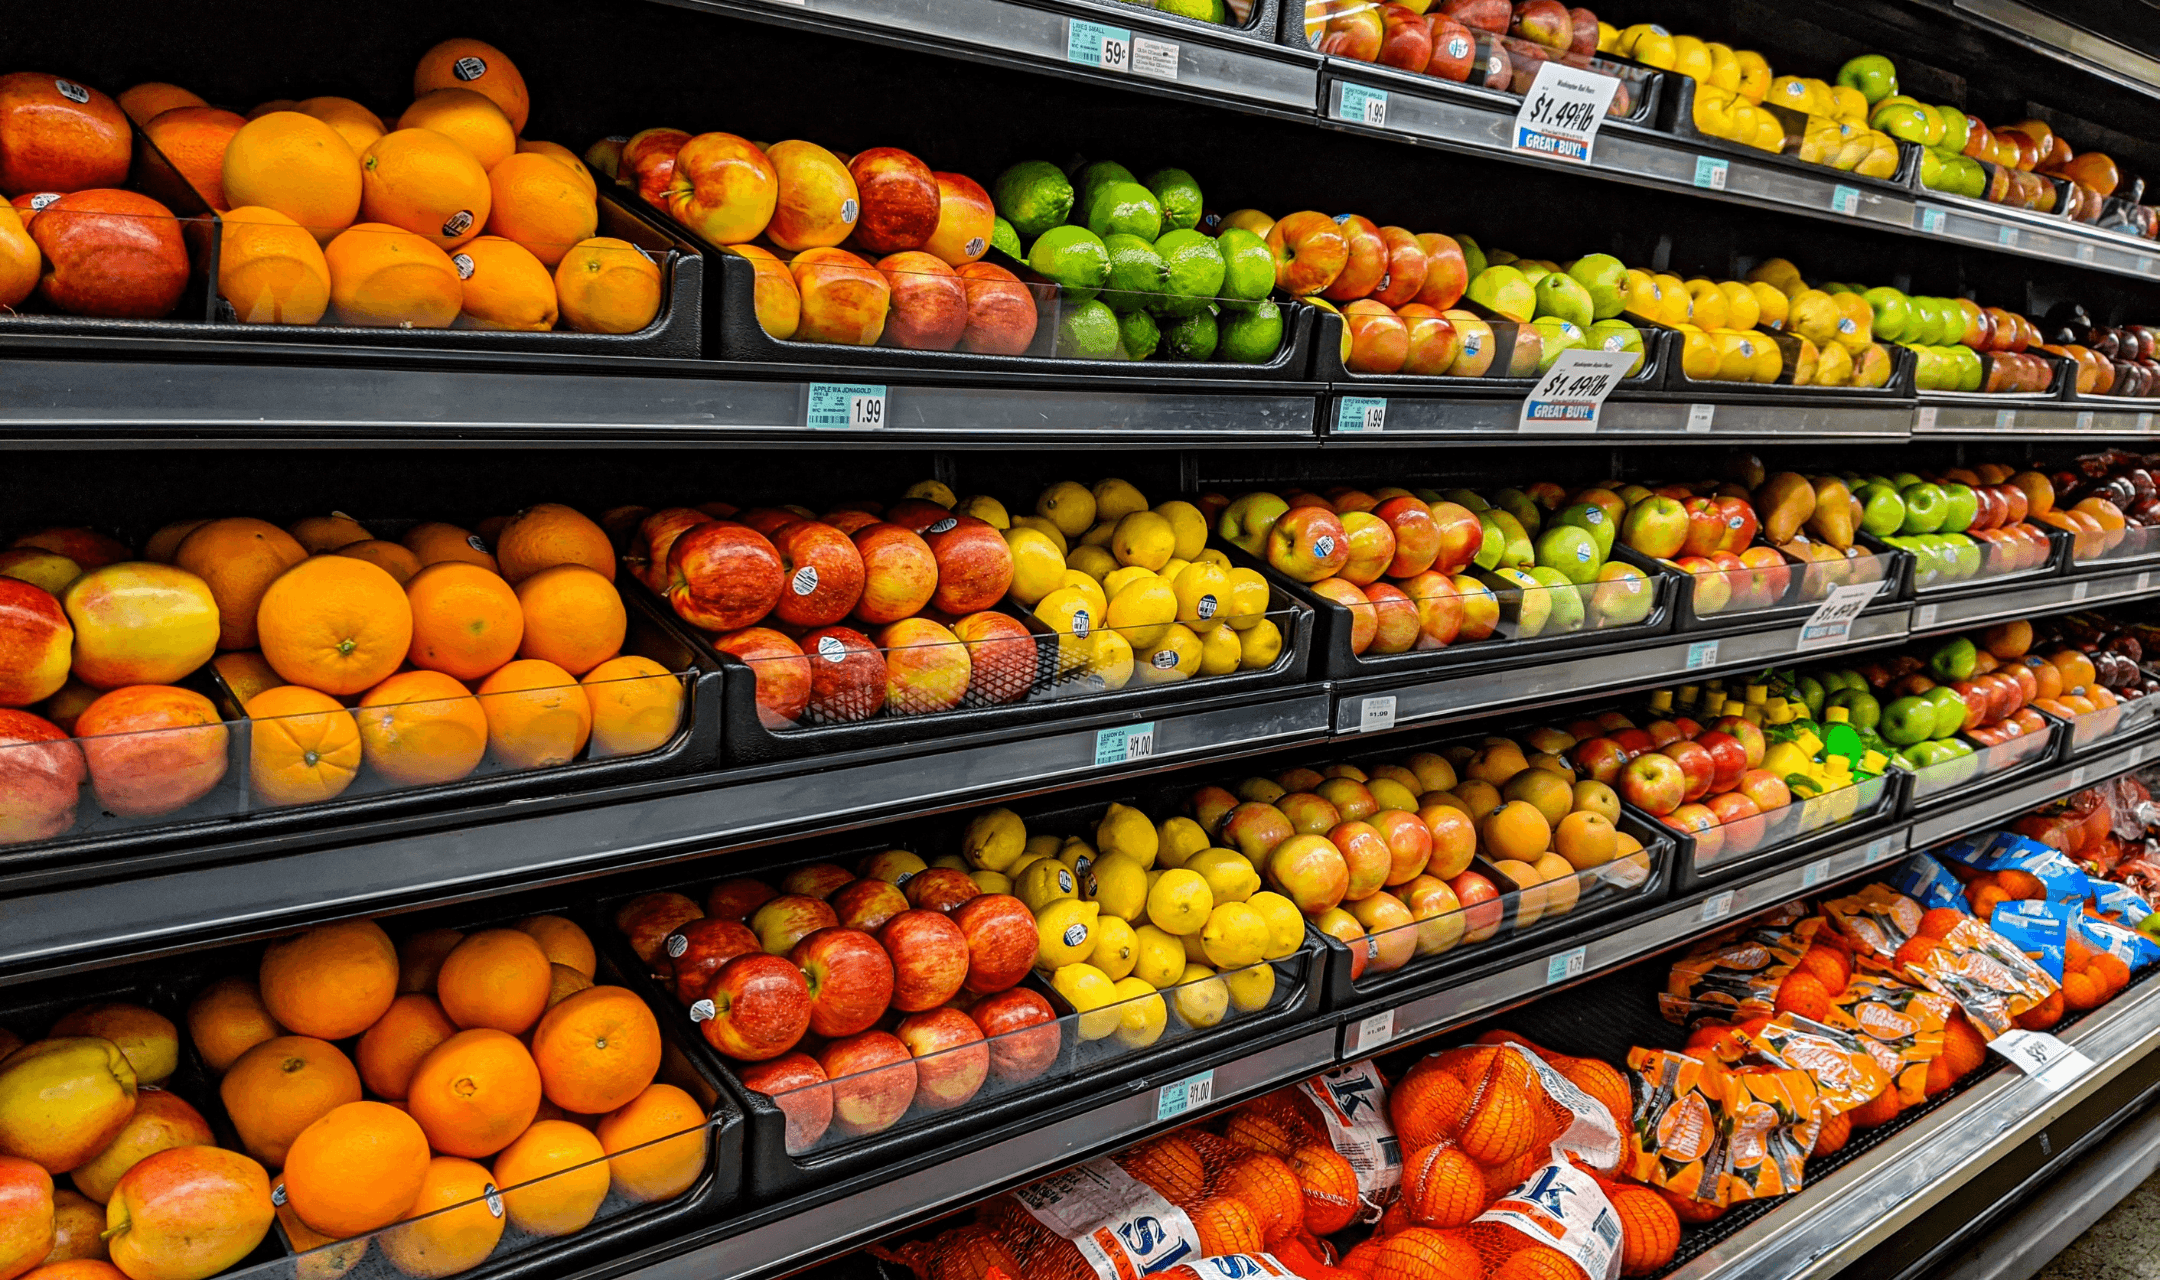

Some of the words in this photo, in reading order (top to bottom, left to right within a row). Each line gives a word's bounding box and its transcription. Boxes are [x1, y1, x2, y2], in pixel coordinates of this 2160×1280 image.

[1089, 24, 1105, 34] SMALL
[1368, 101, 1384, 124] 1.99
[1530, 93, 1579, 128] $1.49
[1577, 103, 1595, 132] lb
[1525, 133, 1557, 152] GREAT
[1558, 140, 1582, 157] BUY!
[1543, 373, 1593, 397] $1.49
[1588, 374, 1610, 397] lb
[856, 399, 881, 423] 1.99
[1367, 408, 1383, 428] 1.99
[1534, 404, 1564, 418] GREAT
[1567, 405, 1589, 418] BUY!
[1676, 1100, 1705, 1158] ORANGES
